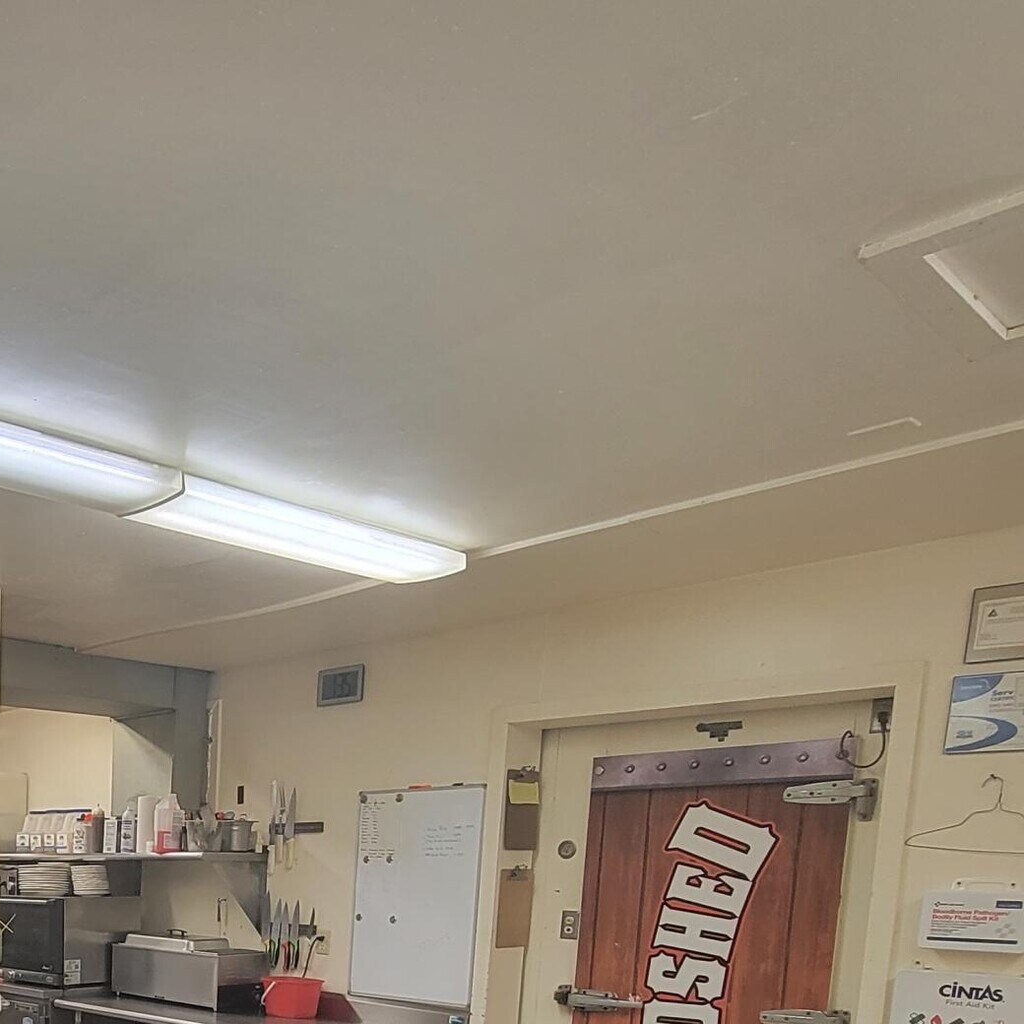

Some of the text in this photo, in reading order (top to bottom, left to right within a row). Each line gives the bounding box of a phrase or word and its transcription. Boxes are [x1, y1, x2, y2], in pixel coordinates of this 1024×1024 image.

[945, 999, 995, 1010] First Aid Kit
